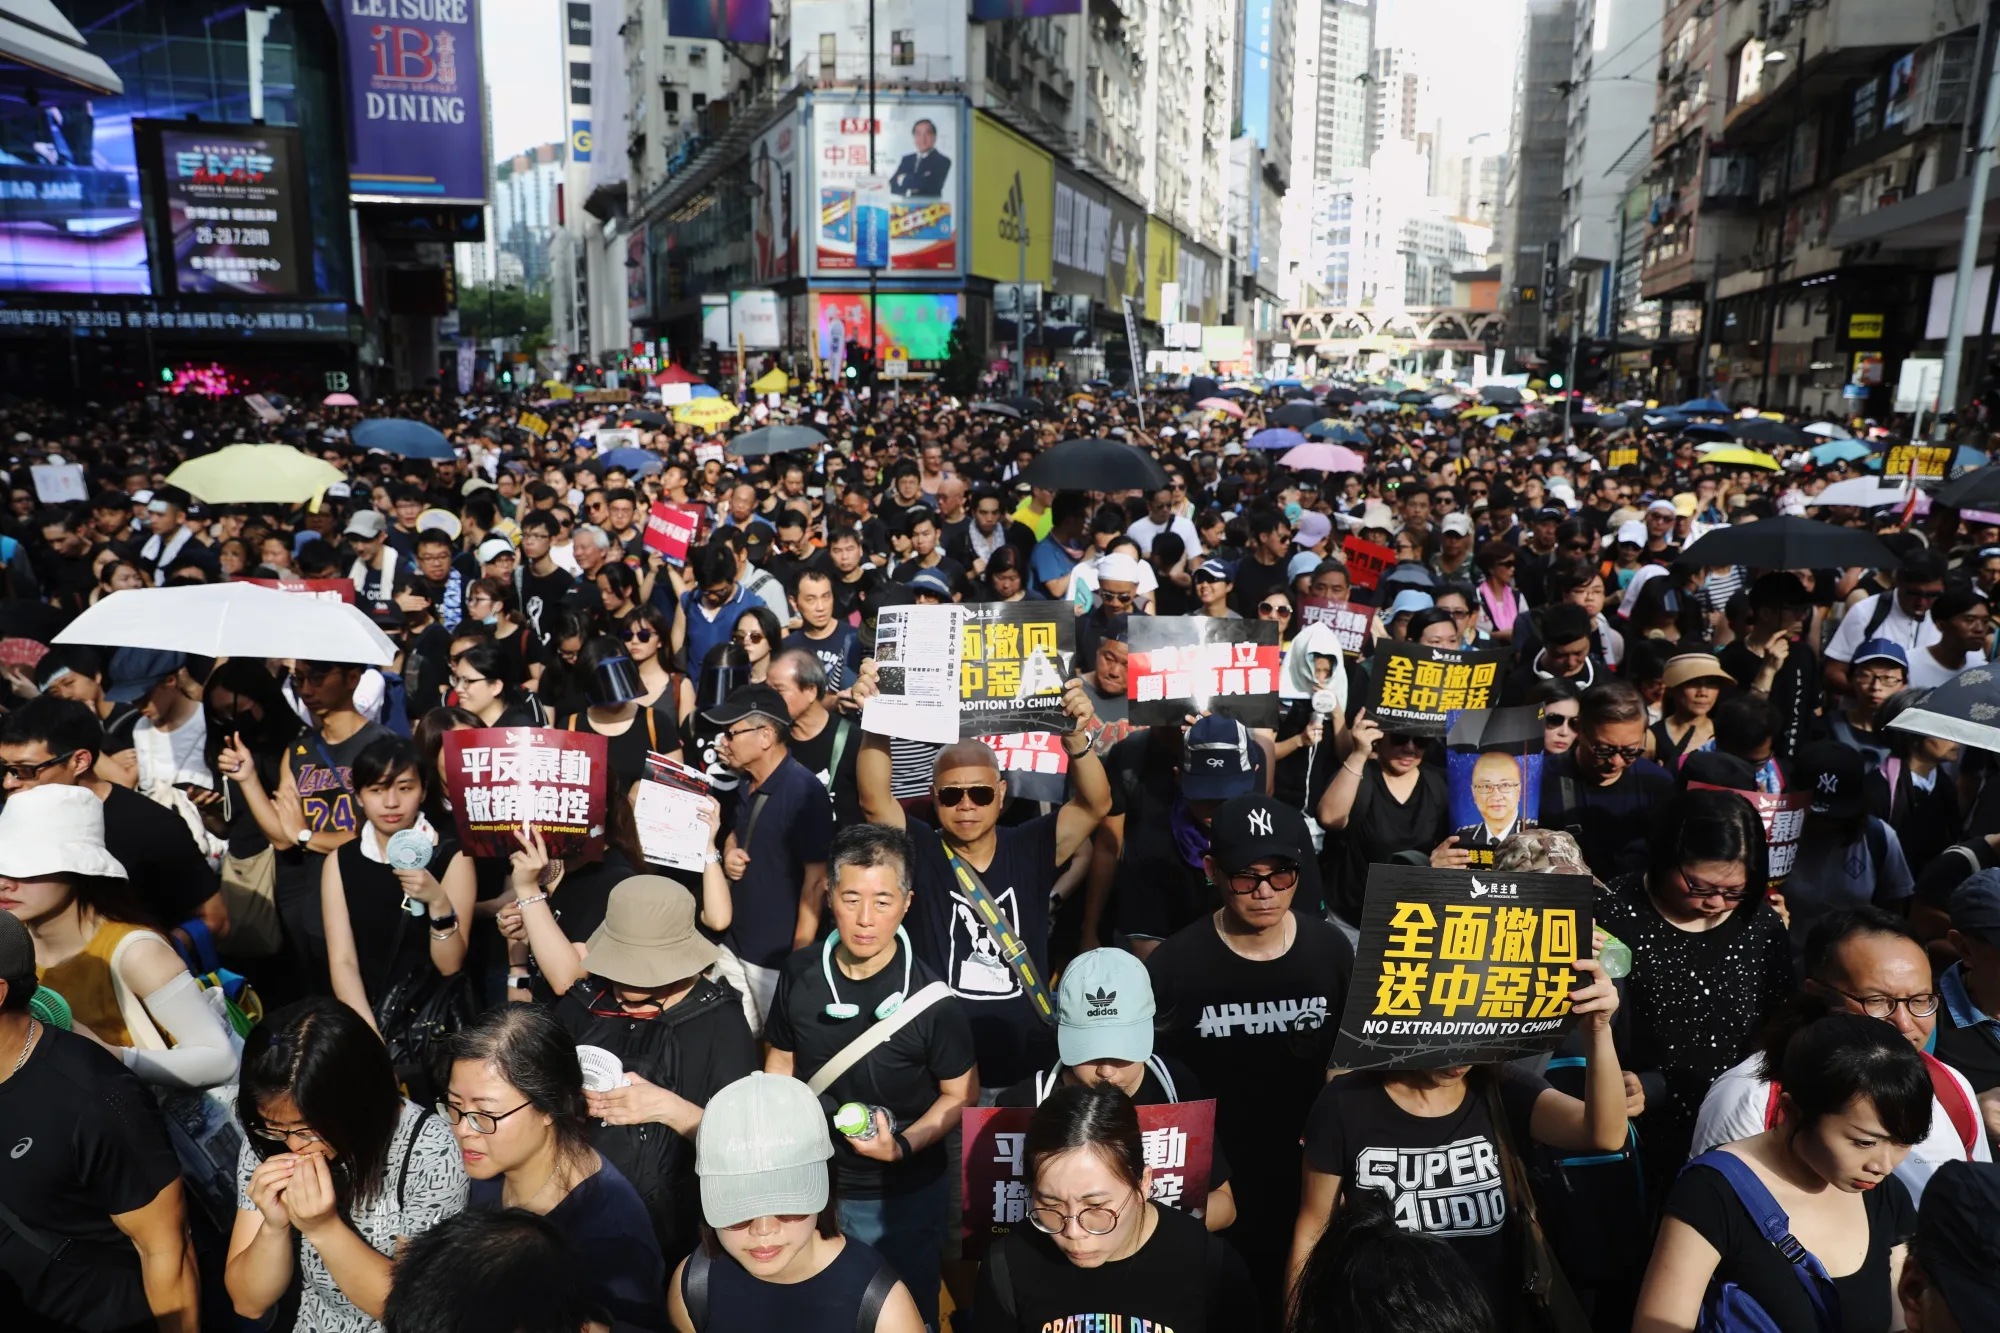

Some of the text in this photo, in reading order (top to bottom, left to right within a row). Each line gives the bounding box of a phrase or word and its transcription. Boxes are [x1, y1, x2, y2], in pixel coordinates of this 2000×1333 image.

[351, 0, 468, 24] LEISURE
[369, 24, 436, 82] iB
[365, 91, 465, 124] DINING
[176, 151, 274, 176] EMF
[962, 622, 1057, 661] 面撤回
[1384, 655, 1497, 689] 全面撤回
[1008, 698, 1025, 710] TO
[1027, 696, 1061, 709] CHINA
[1376, 706, 1390, 716] NO
[1379, 681, 1490, 713] 送中惡法
[461, 746, 591, 786] 平反暴動
[1817, 772, 1839, 793] NY
[464, 784, 590, 824] 撤銷檢控
[552, 825, 587, 834] protesters!
[1247, 808, 1273, 836] NY
[1491, 883, 1517, 894] 民主黨
[1384, 902, 1577, 964] 全面撤回
[1372, 962, 1577, 1018] 送中惡法
[1087, 1007, 1118, 1017] adidas
[1362, 1018, 1563, 1035] NO EXTRADITION TO CHINA
[1356, 1140, 1500, 1200] SUPER
[1394, 1187, 1505, 1233] AUDIO
[1130, 1316, 1175, 1333] DE
